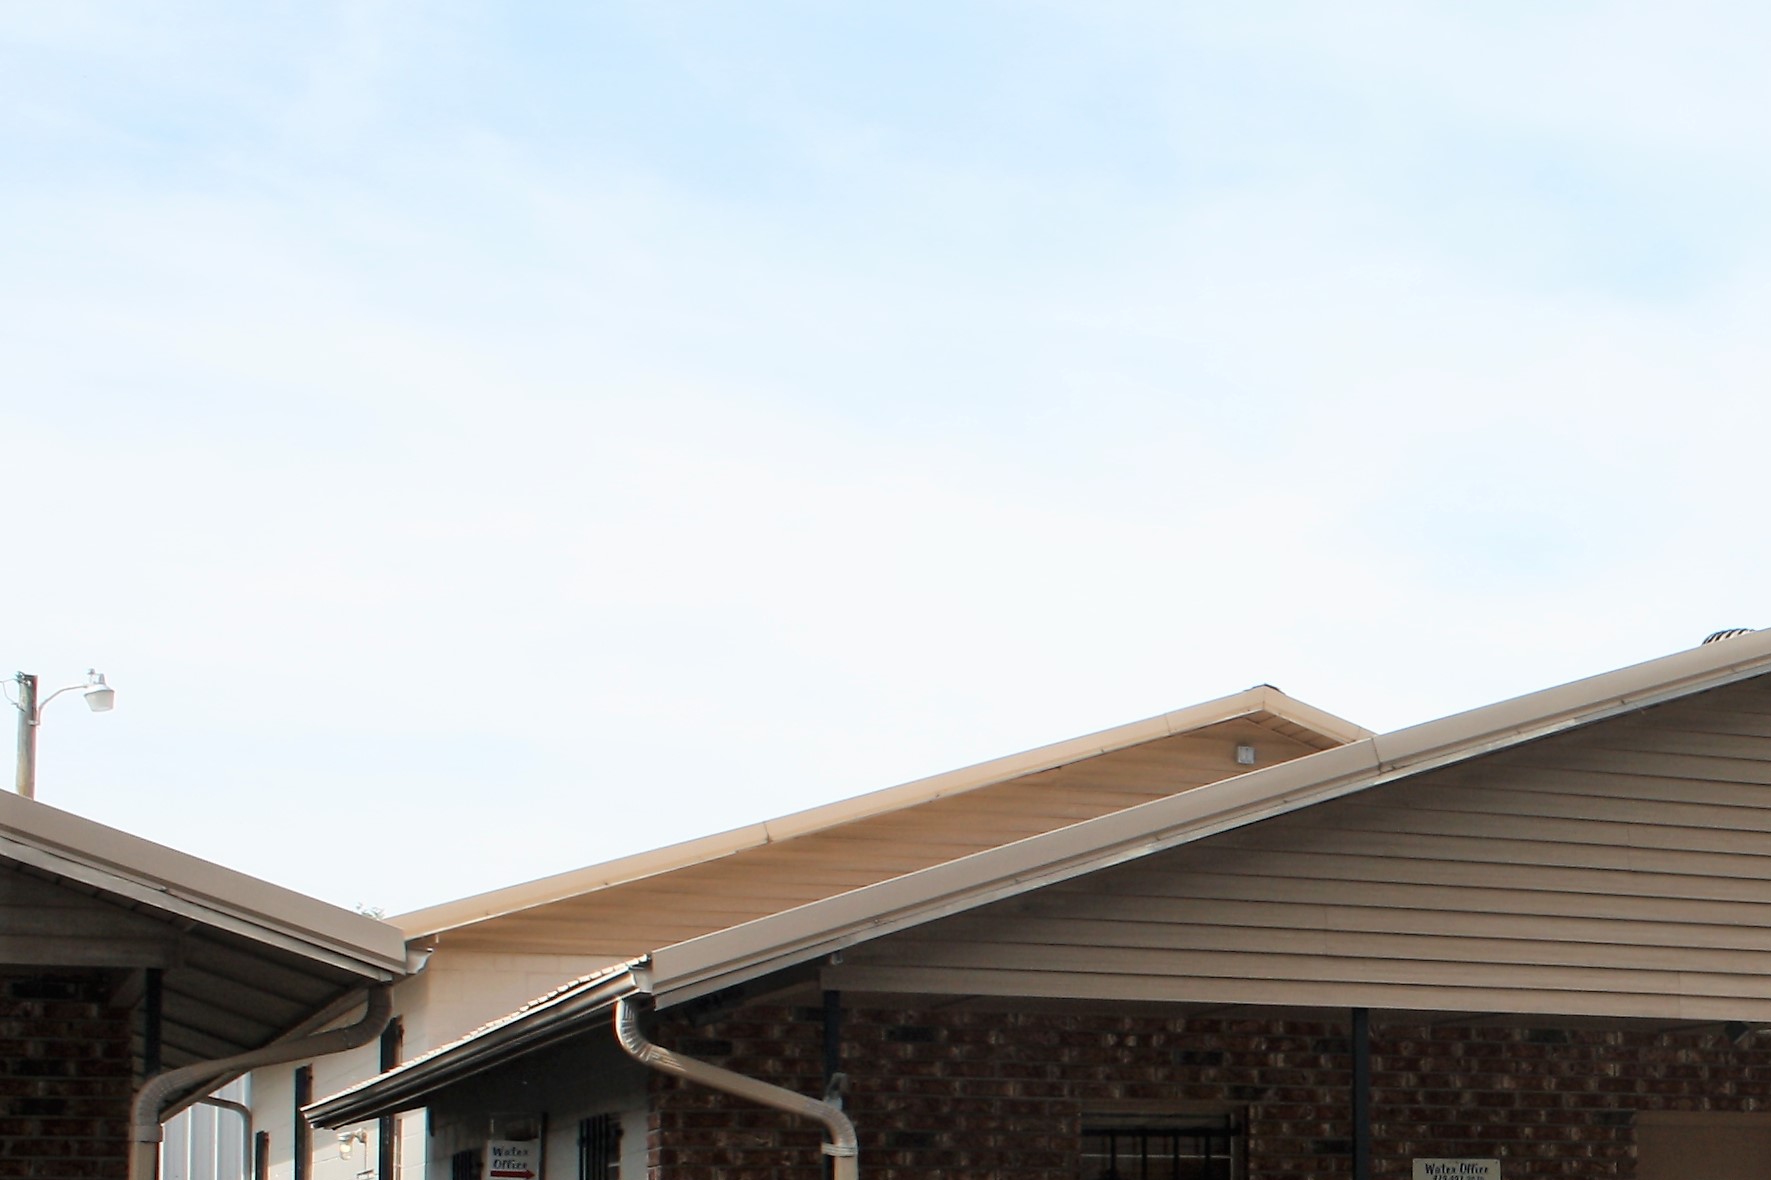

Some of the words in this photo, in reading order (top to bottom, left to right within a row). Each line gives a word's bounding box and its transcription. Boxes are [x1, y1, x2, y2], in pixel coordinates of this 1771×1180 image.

[493, 1146, 529, 1157] Water
[493, 1159, 528, 1170] Office
[1425, 1163, 1456, 1175] Water
[1460, 1163, 1488, 1174] Office
